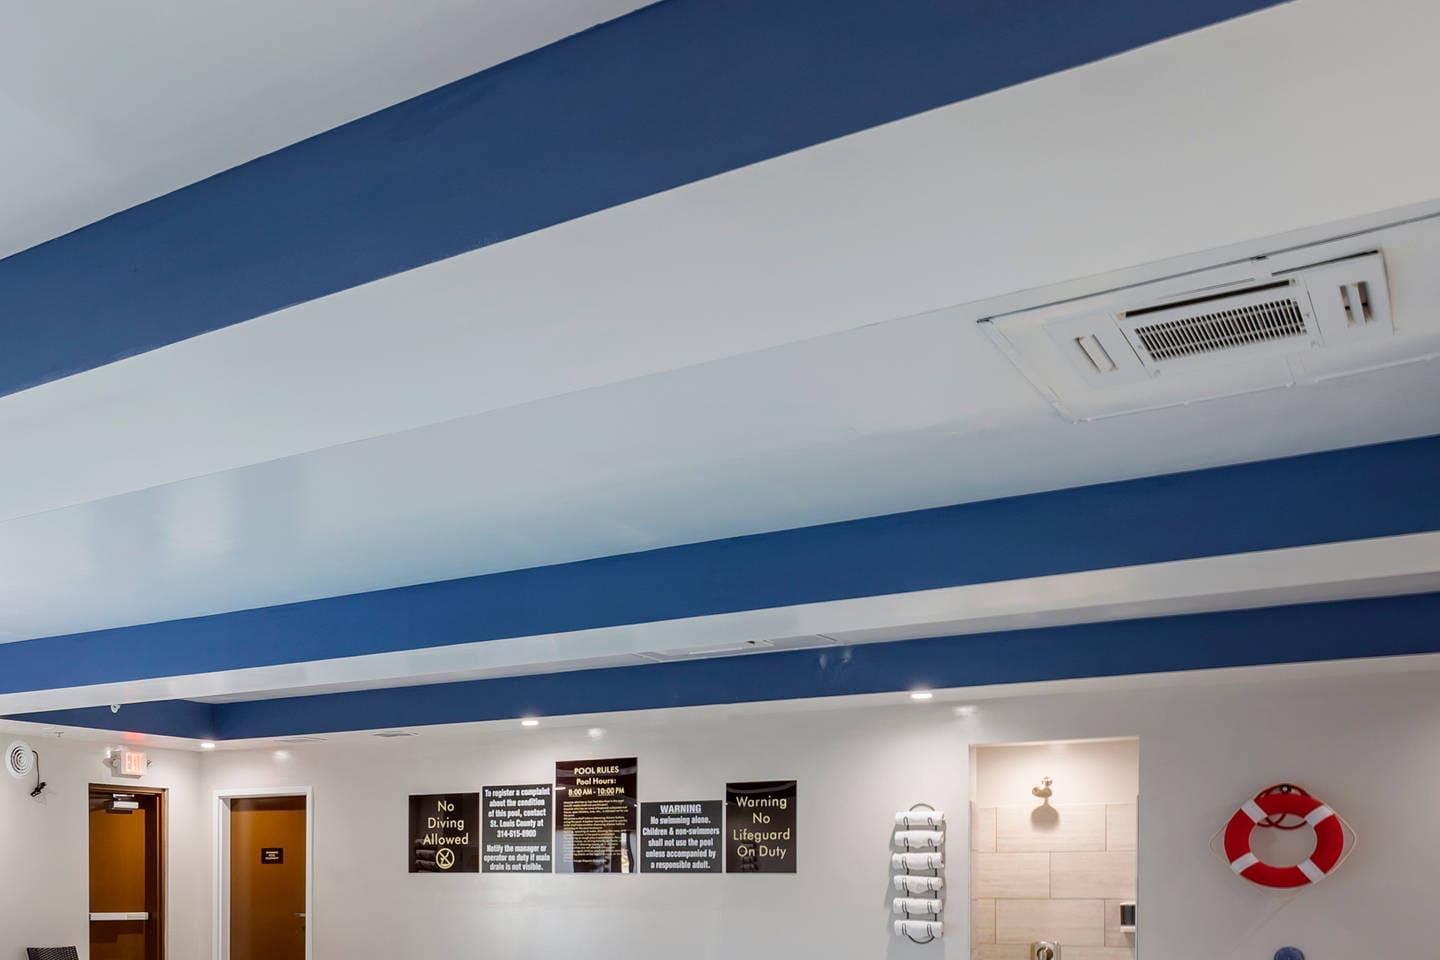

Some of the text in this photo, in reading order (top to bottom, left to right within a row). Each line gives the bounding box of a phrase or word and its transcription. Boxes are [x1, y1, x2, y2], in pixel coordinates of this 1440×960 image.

[573, 766, 620, 775] POOL RULES
[593, 777, 616, 785] Hours:
[493, 788, 515, 798] register
[521, 787, 550, 797] complaint
[438, 800, 455, 812] No
[489, 799, 505, 807] about
[518, 798, 545, 806] condition
[736, 795, 787, 809] Warning
[495, 809, 506, 817] this
[660, 804, 702, 814] WARNING
[650, 815, 711, 825] No swimming alone.
[752, 812, 771, 824] No
[427, 816, 464, 831] Diving
[500, 819, 515, 827] Louis
[516, 819, 536, 828] County
[642, 826, 720, 835] Children & non-swimmers
[733, 827, 790, 843] Lifeguard
[423, 832, 469, 845] Allowed
[648, 838, 663, 846] shall
[664, 838, 675, 846] not
[687, 838, 698, 846] the
[699, 838, 713, 848] pool
[504, 844, 514, 852] the
[737, 845, 787, 860] On Duty
[517, 854, 529, 863] duty
[645, 849, 716, 859] unless accompanied by
[656, 860, 691, 870] responsible
[692, 860, 711, 868] adult.
